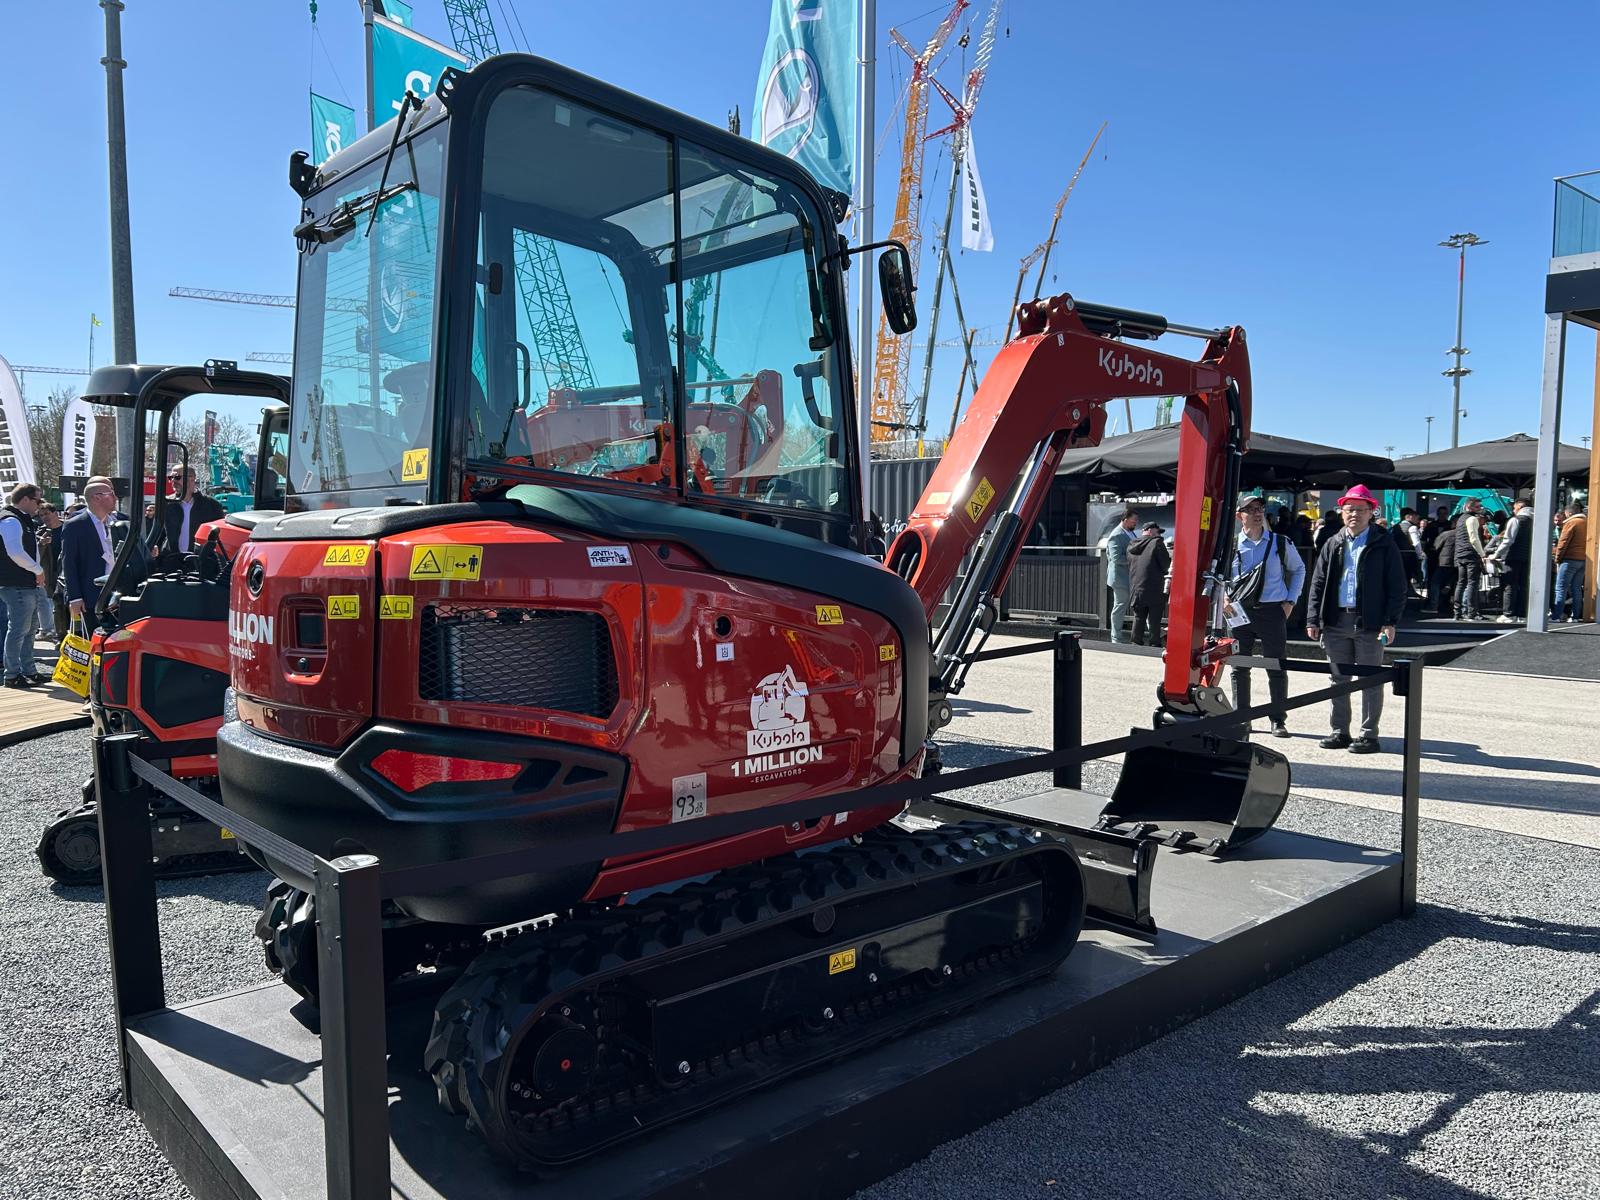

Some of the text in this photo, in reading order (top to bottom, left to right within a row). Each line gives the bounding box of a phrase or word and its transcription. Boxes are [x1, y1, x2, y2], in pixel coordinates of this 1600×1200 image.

[1098, 347, 1163, 388] Kubota
[753, 728, 805, 749] Kubota
[731, 745, 823, 777] 1 MILLION
